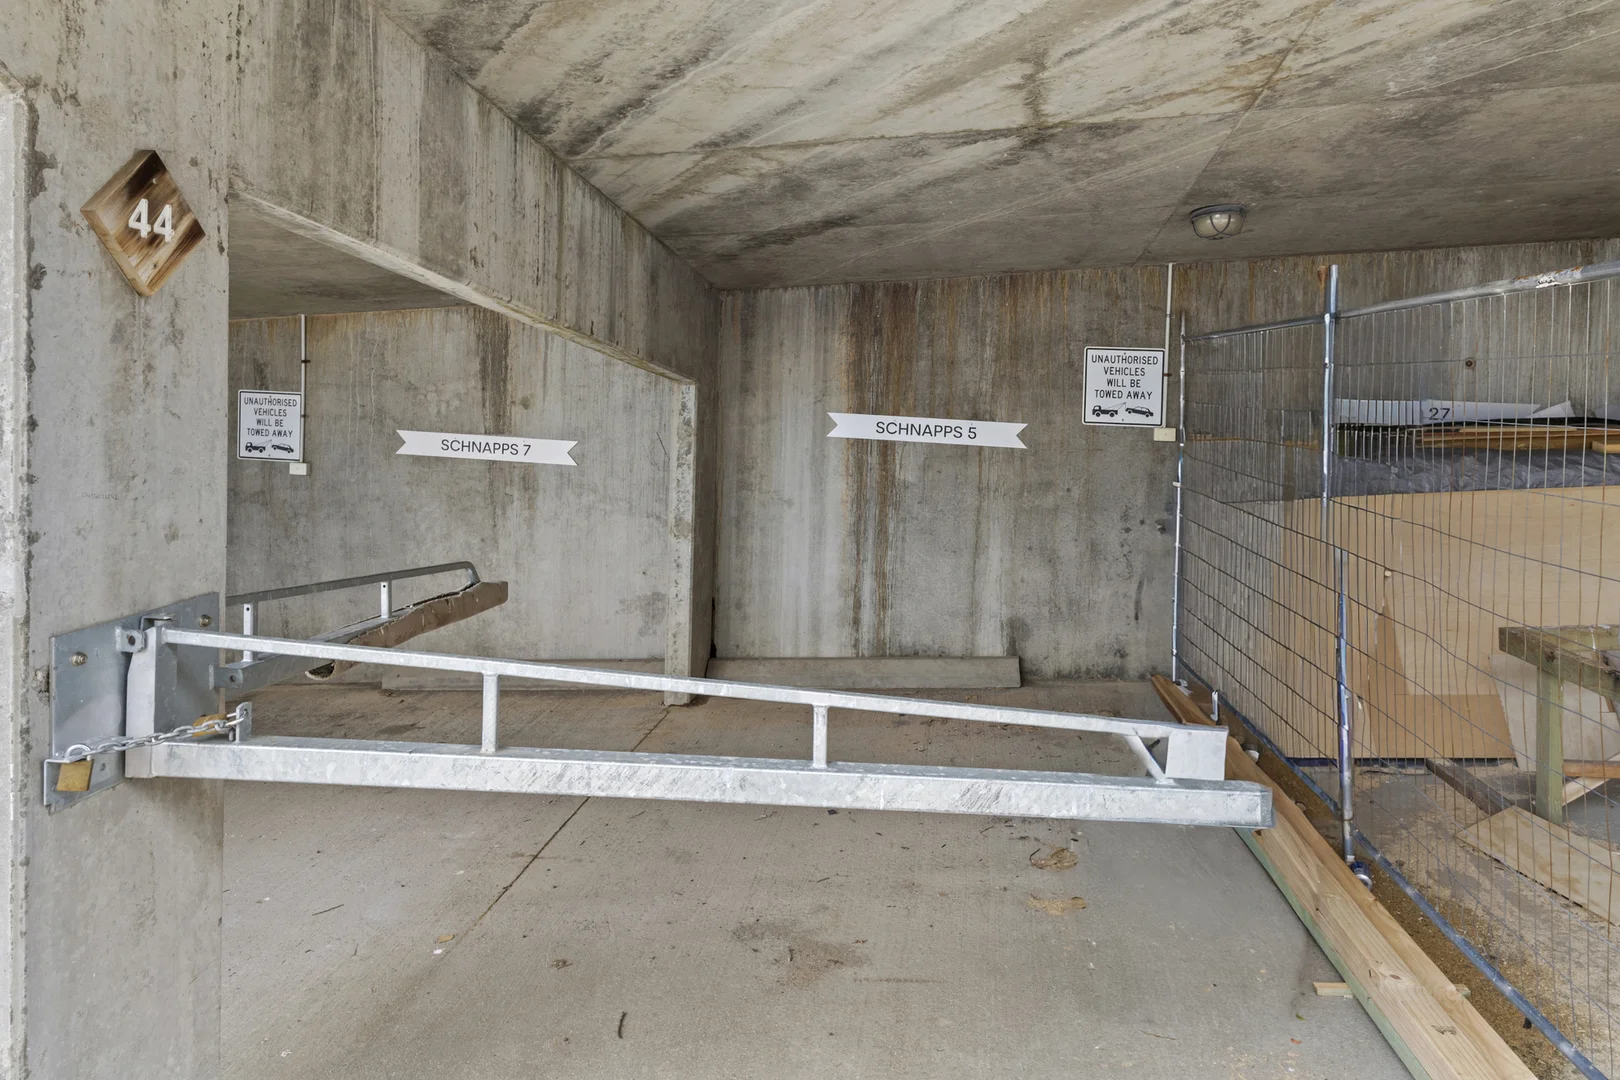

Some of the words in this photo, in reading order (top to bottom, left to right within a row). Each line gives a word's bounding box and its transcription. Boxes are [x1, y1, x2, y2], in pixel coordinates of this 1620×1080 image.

[128, 198, 175, 243] 44
[1091, 354, 1159, 365] UNAUTHORISED
[1103, 366, 1146, 377] VEHICLES
[1106, 378, 1127, 388] WILL
[1129, 379, 1141, 388] BE
[1094, 389, 1123, 399] TOWED
[1126, 390, 1153, 400] AWAY
[243, 396, 298, 407] UNAUTHORISED
[253, 407, 288, 417] VEHICLES
[1428, 407, 1451, 421] 27
[256, 418, 272, 427] WILL
[274, 419, 284, 428] BE
[247, 427, 270, 437] TOWED
[271, 429, 293, 438] AWAY
[875, 421, 963, 439] SCHNAPPS
[967, 426, 977, 440] 5
[440, 439, 519, 456] SCHNAPPS
[522, 444, 532, 457] 7
